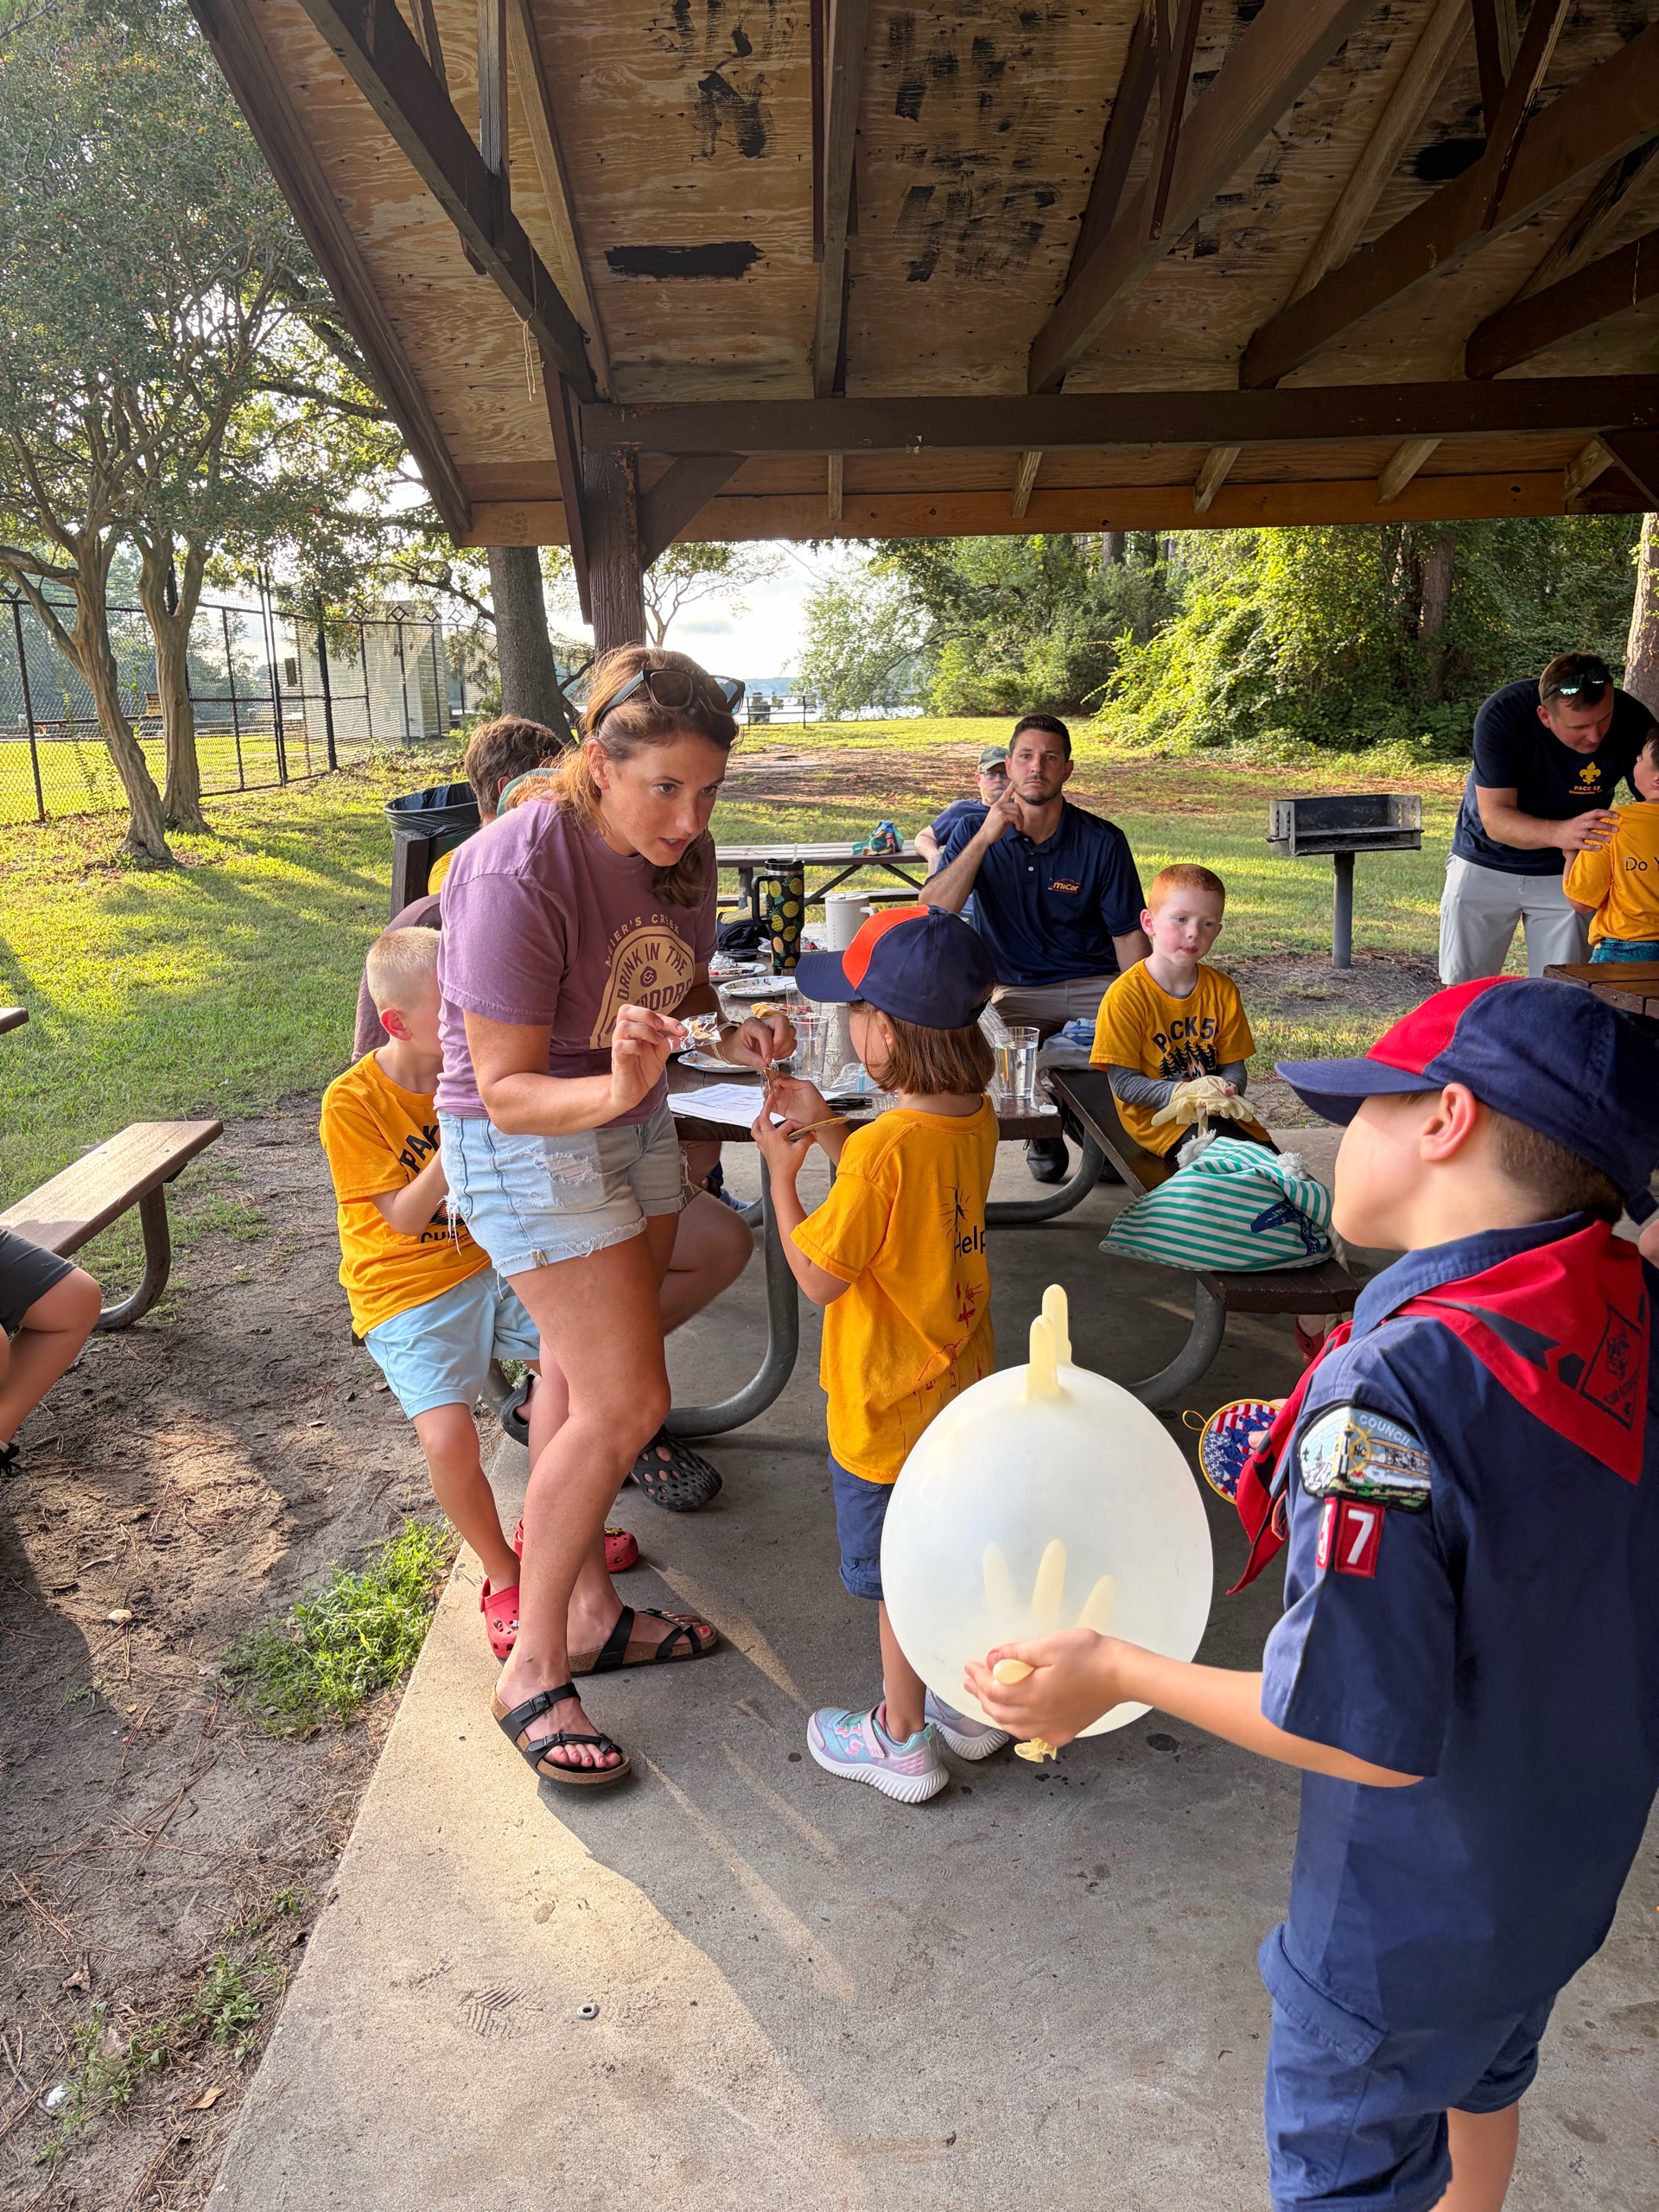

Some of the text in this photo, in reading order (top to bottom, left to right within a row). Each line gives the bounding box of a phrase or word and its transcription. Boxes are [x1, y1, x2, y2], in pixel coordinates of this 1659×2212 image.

[1625, 856, 1648, 871] Do
[651, 913, 679, 935] CREEK
[616, 942, 688, 1001] DRINK IN THE
[1152, 1015, 1220, 1054] PCK 5
[1359, 1414, 1410, 1446] COUNCIL
